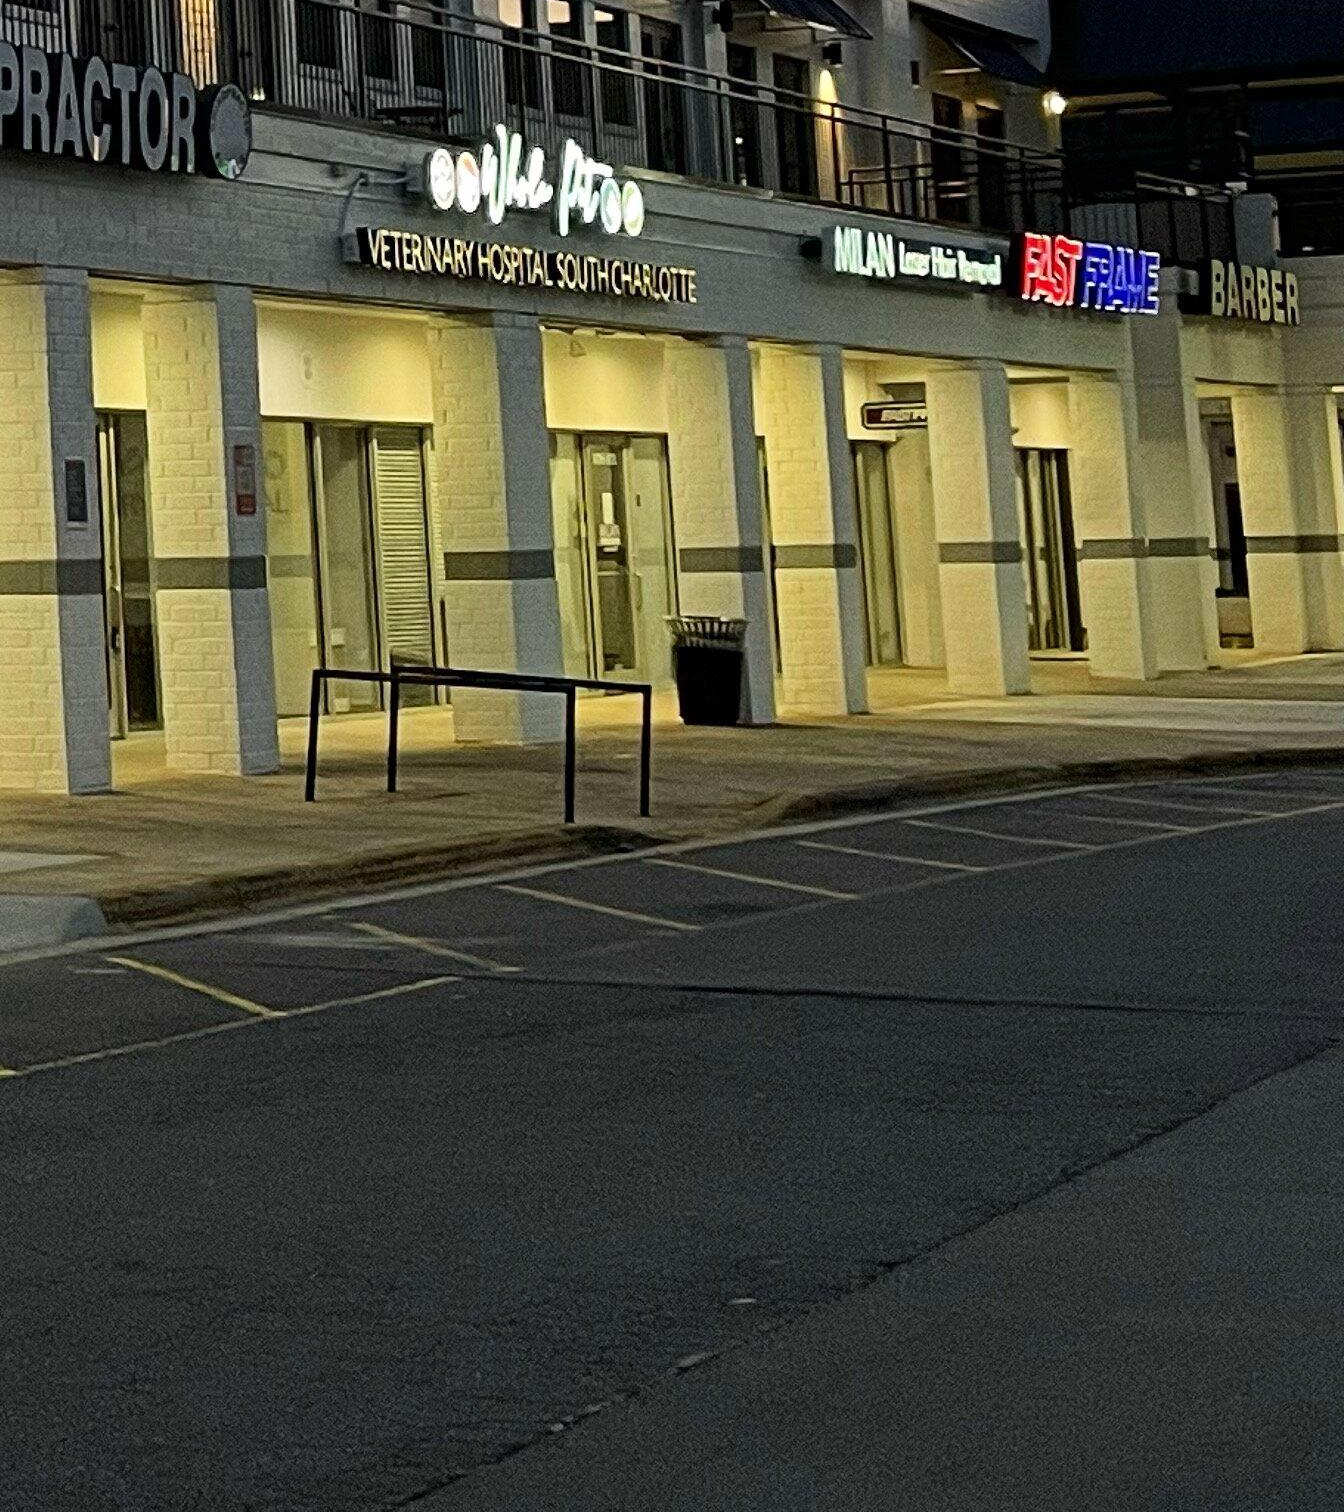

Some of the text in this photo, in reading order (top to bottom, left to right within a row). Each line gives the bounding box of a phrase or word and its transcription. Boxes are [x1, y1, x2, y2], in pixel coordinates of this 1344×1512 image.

[367, 228, 698, 304] VETERINARY HOSPITAL SOUTH CHARLOTTE
[833, 224, 897, 279] MILAN
[1211, 258, 1302, 326] BARBER
